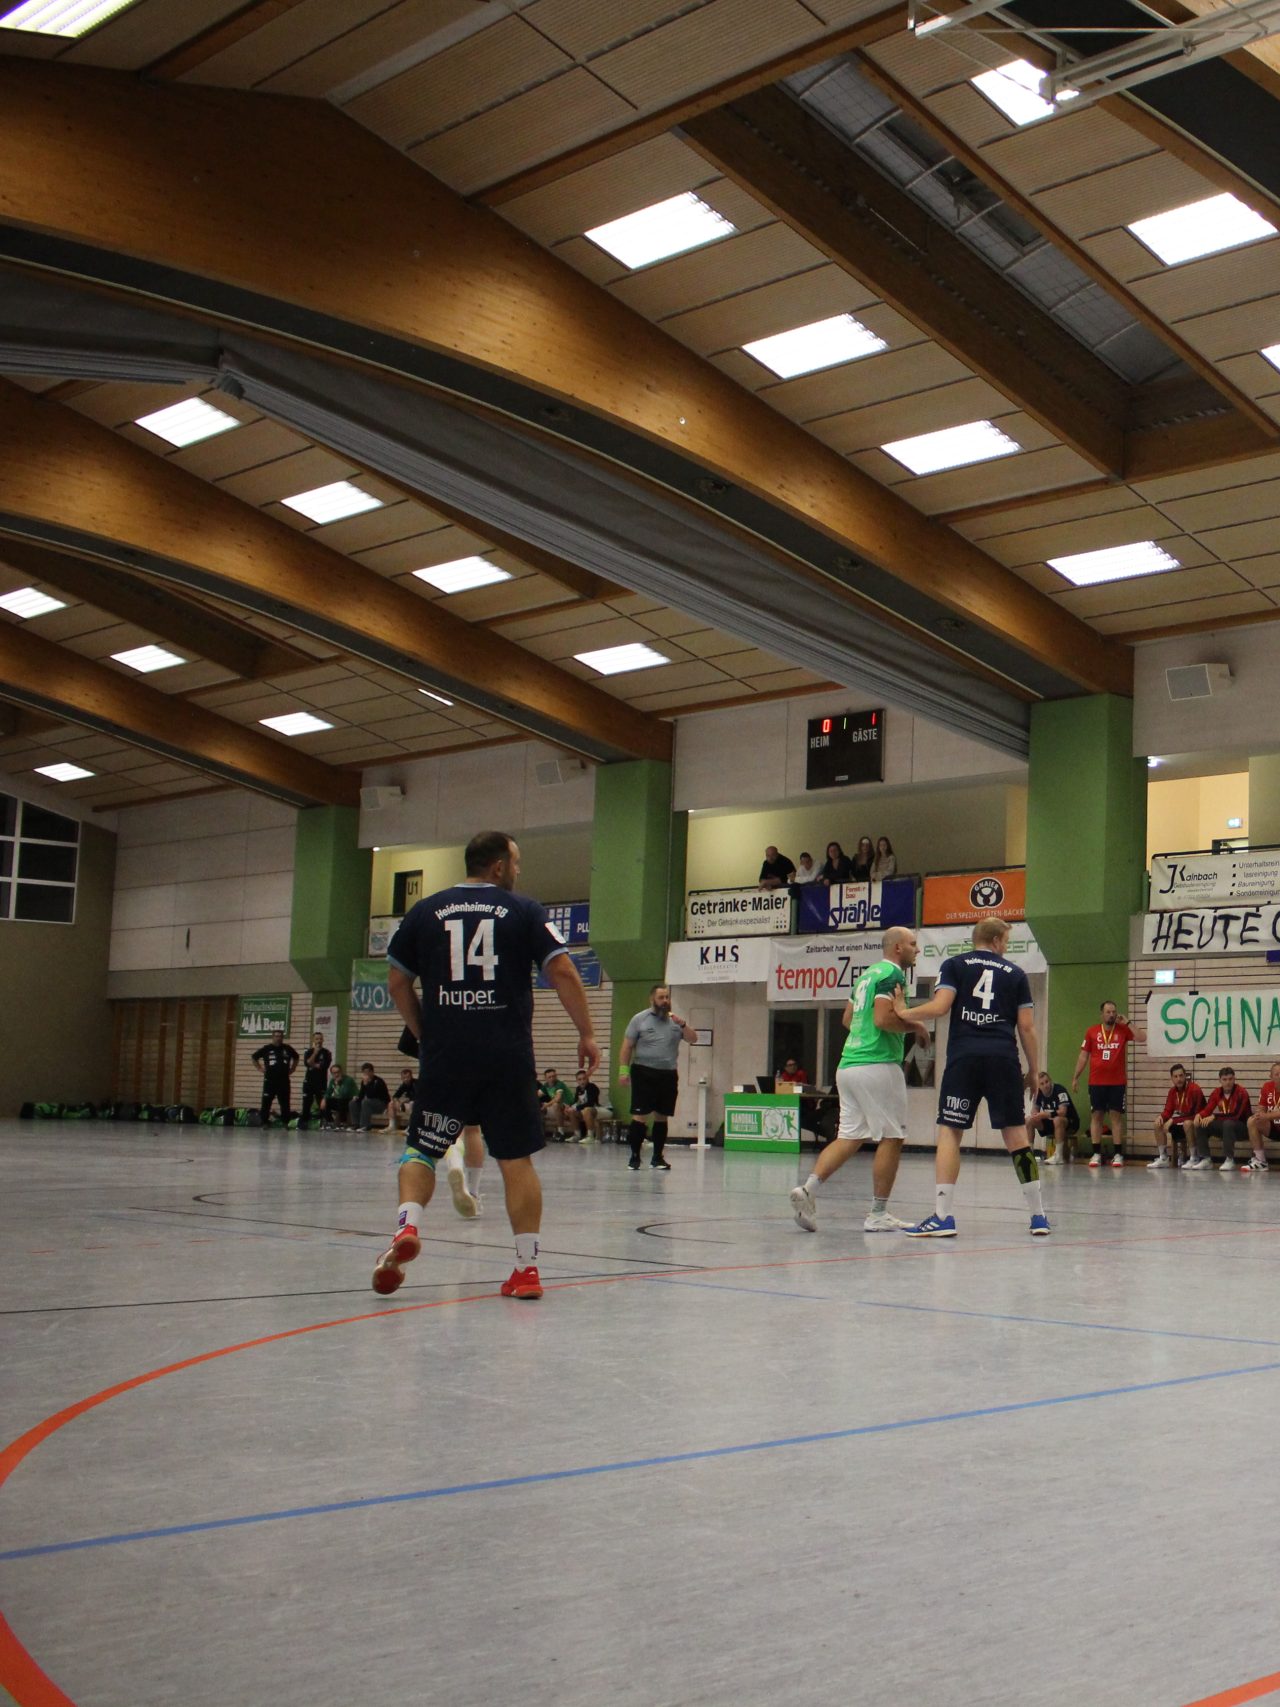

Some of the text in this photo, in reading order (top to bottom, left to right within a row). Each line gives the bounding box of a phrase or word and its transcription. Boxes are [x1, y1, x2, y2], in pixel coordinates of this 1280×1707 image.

[822, 719, 831, 733] 0
[811, 735, 830, 749] HEIM
[853, 728, 878, 743] GÄSTE
[407, 881, 418, 895] U1
[974, 880, 999, 892] GNAIER
[434, 902, 509, 920] Heidenheimer SB
[690, 895, 788, 916] Getränke-Maier
[959, 908, 1025, 920] SPEZIALITÄTEN-BÄCKE
[1152, 910, 1262, 951] HEUTE
[444, 918, 499, 982] 14
[806, 944, 834, 953] Zeitarbeit
[835, 943, 845, 952] hat
[846, 942, 862, 951] einen
[972, 969, 995, 1010] 4
[263, 1018, 285, 1031] Benz
[946, 1095, 970, 1111] TRIO
[422, 1110, 461, 1135] TRIO
